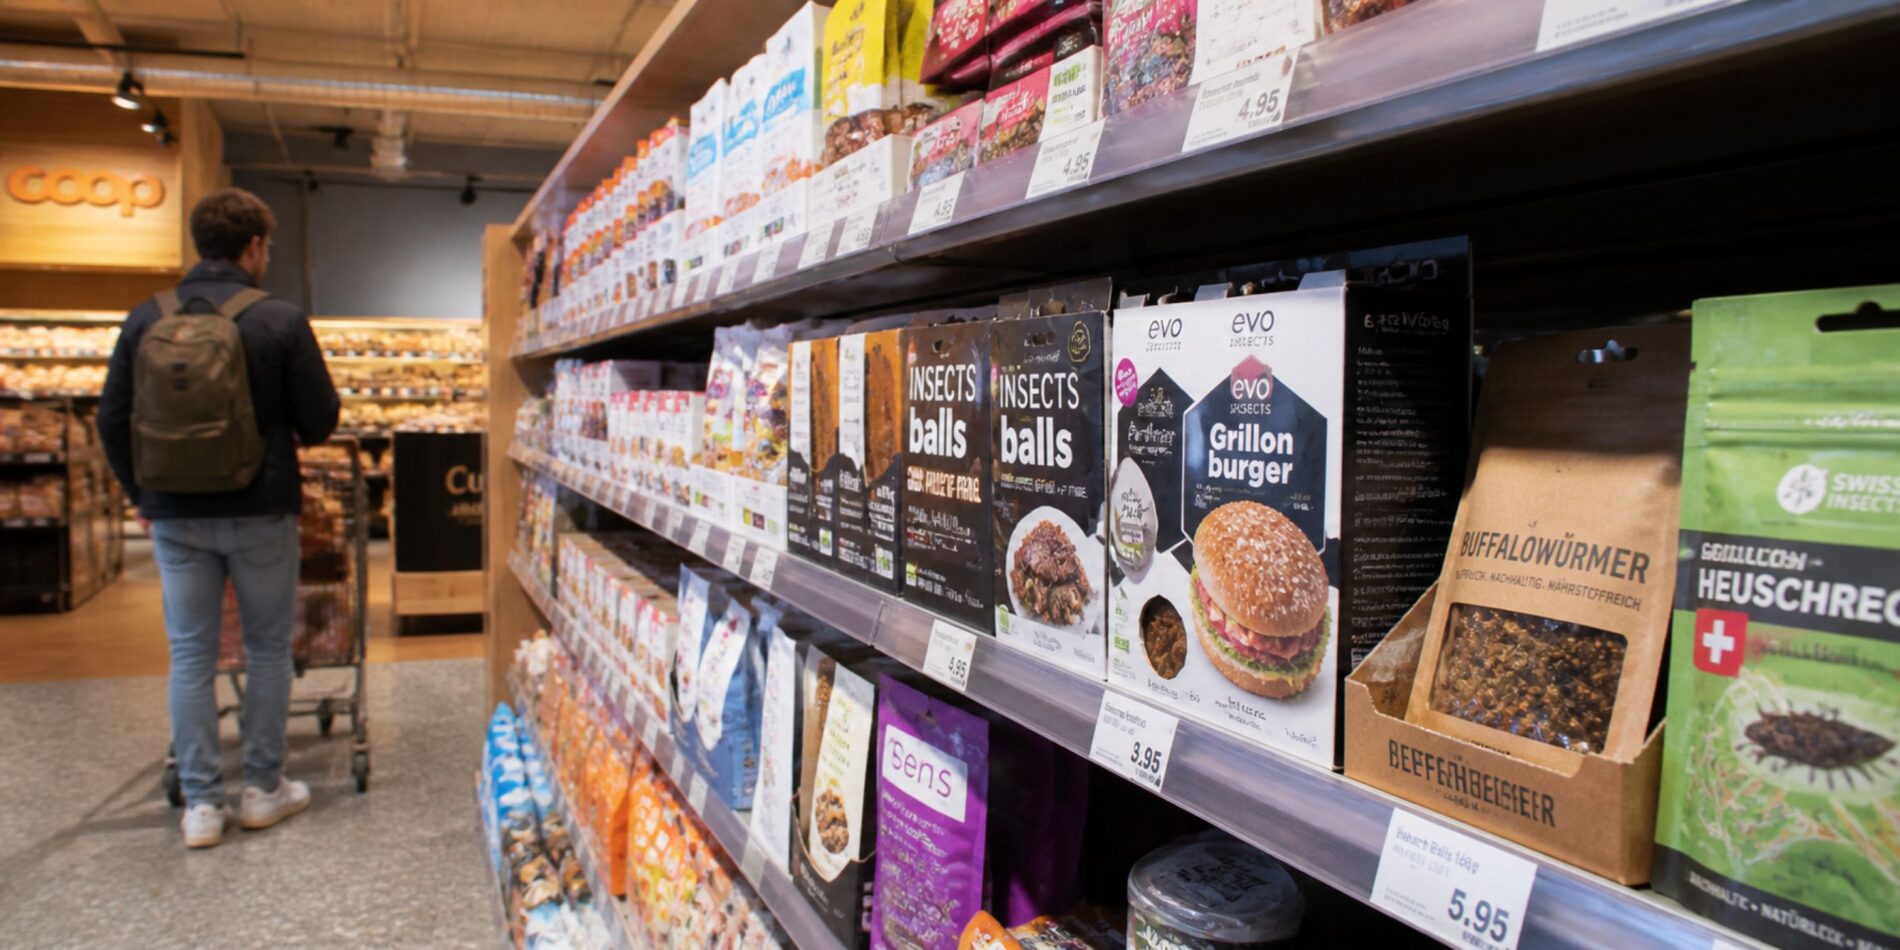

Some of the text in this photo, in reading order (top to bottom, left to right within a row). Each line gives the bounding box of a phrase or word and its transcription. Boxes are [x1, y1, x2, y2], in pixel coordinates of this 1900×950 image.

[6, 166, 166, 218] coop
[1147, 318, 1183, 340] evo
[1228, 310, 1275, 334] evo
[909, 363, 976, 402] INSECTS
[999, 371, 1081, 410] INSECTS
[1231, 377, 1270, 400] evo
[909, 406, 968, 459] balls
[1000, 414, 1074, 469] balls
[1209, 422, 1294, 456] Grillon
[1208, 450, 1294, 488] burger
[1447, 887, 1510, 943] 5.95
